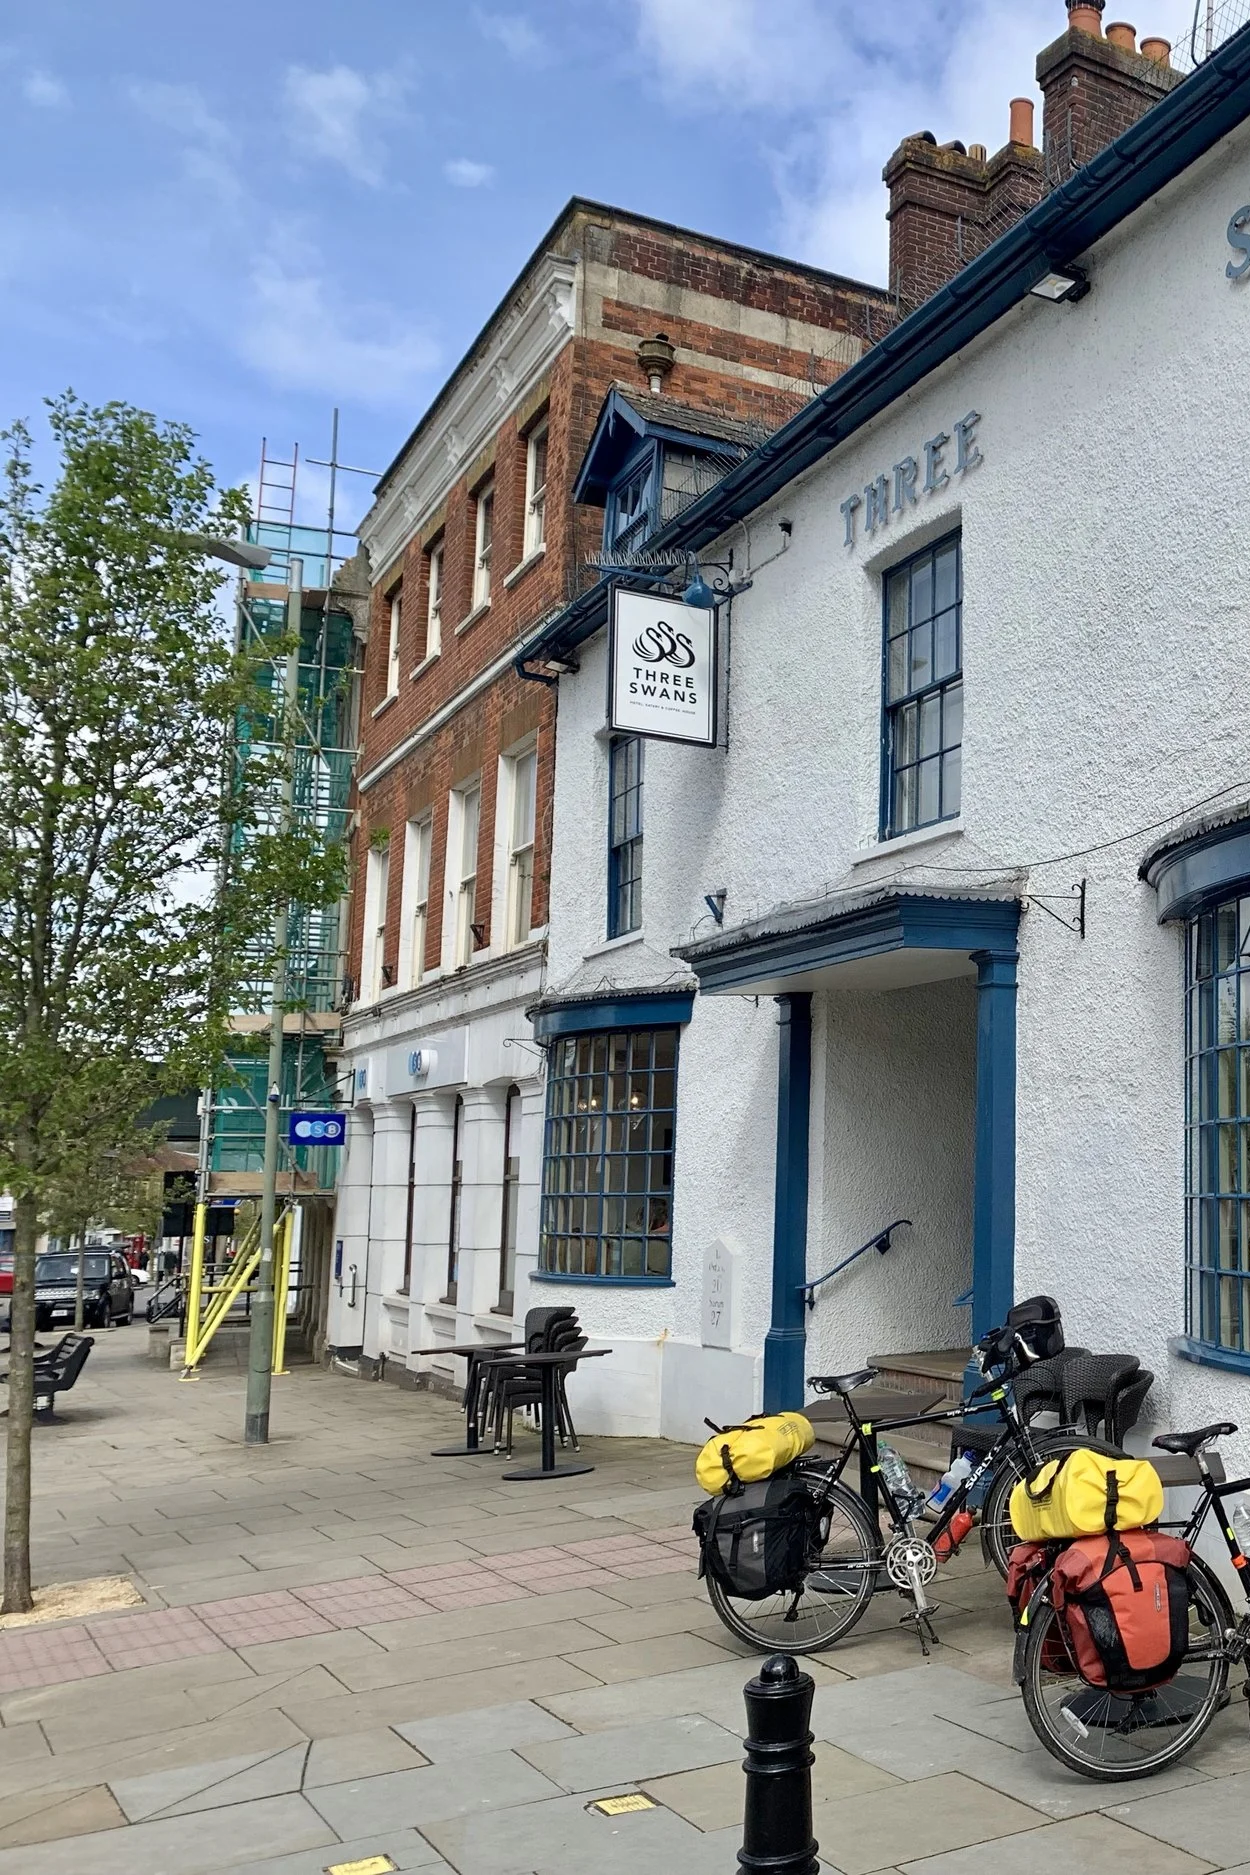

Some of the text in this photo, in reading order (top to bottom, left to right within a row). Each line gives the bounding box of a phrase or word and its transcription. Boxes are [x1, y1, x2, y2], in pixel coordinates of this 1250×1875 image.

[840, 410, 981, 547] THREE
[633, 667, 694, 689] THREE
[629, 682, 697, 704] SWANS
[298, 1123, 339, 1136] TSB
[965, 1452, 993, 1490] SURLY
